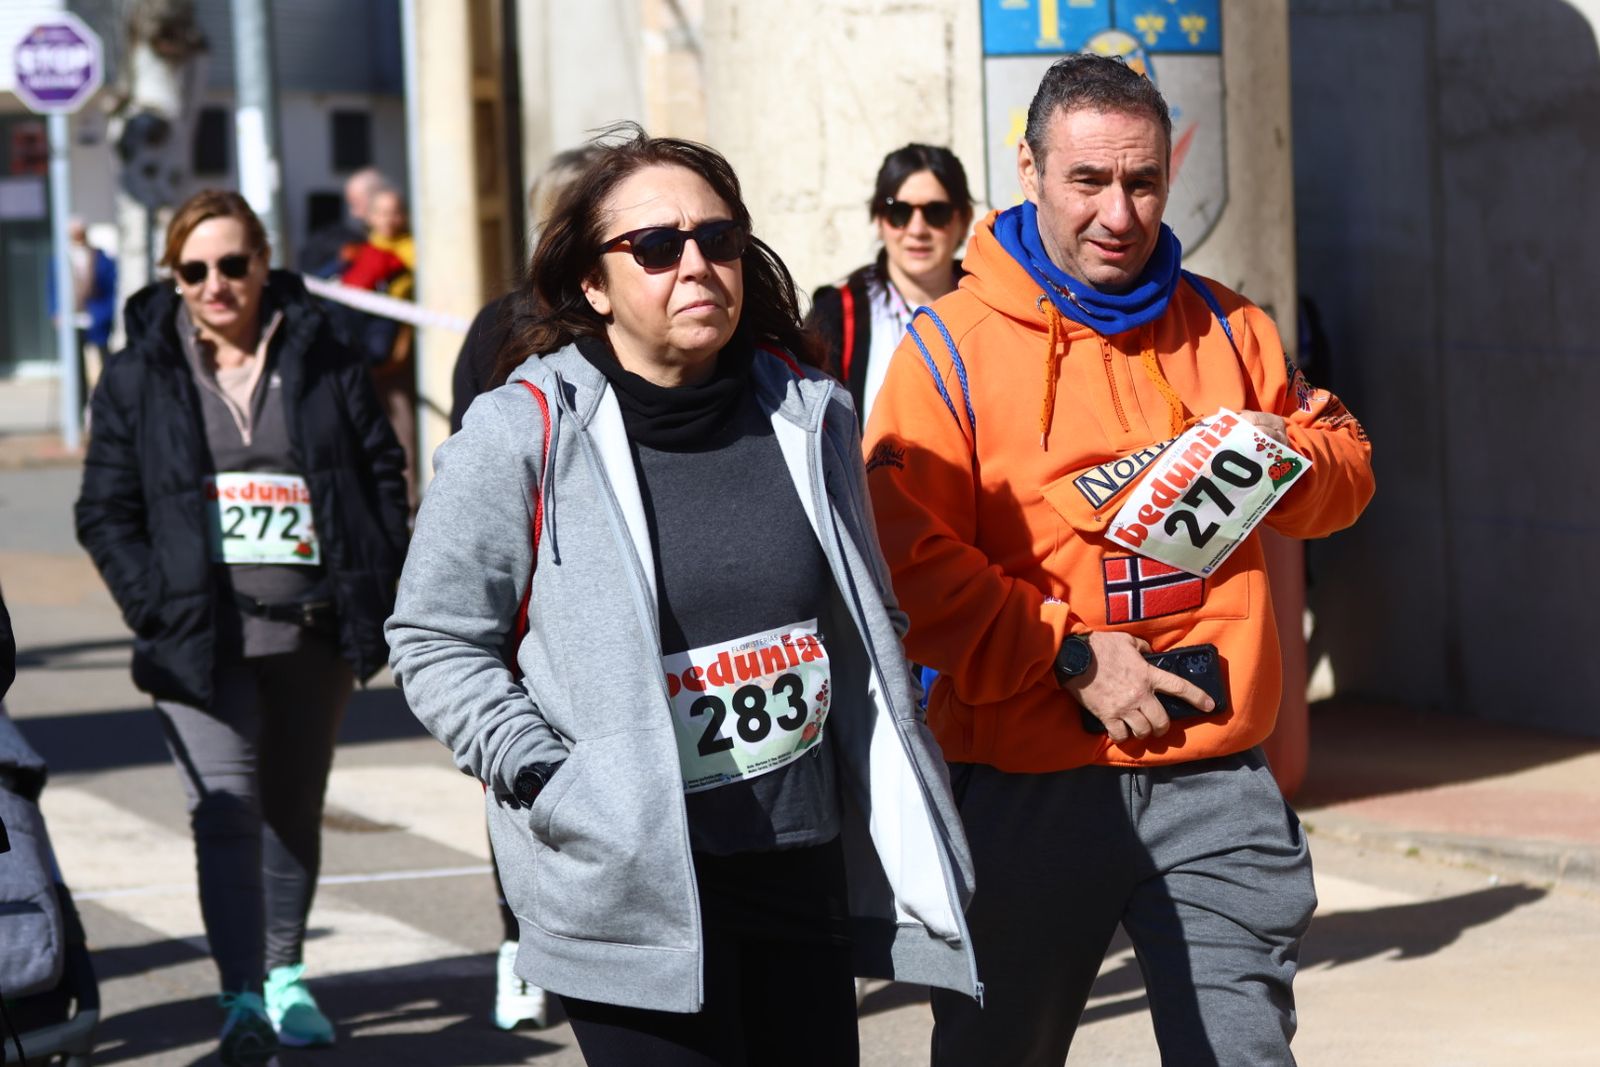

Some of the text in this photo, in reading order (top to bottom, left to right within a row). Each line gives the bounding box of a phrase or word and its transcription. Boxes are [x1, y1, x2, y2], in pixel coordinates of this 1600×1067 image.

[222, 506, 301, 540] 272
[1114, 414, 1240, 548] bedunia
[1163, 449, 1263, 549] 270
[689, 673, 808, 757] 283
